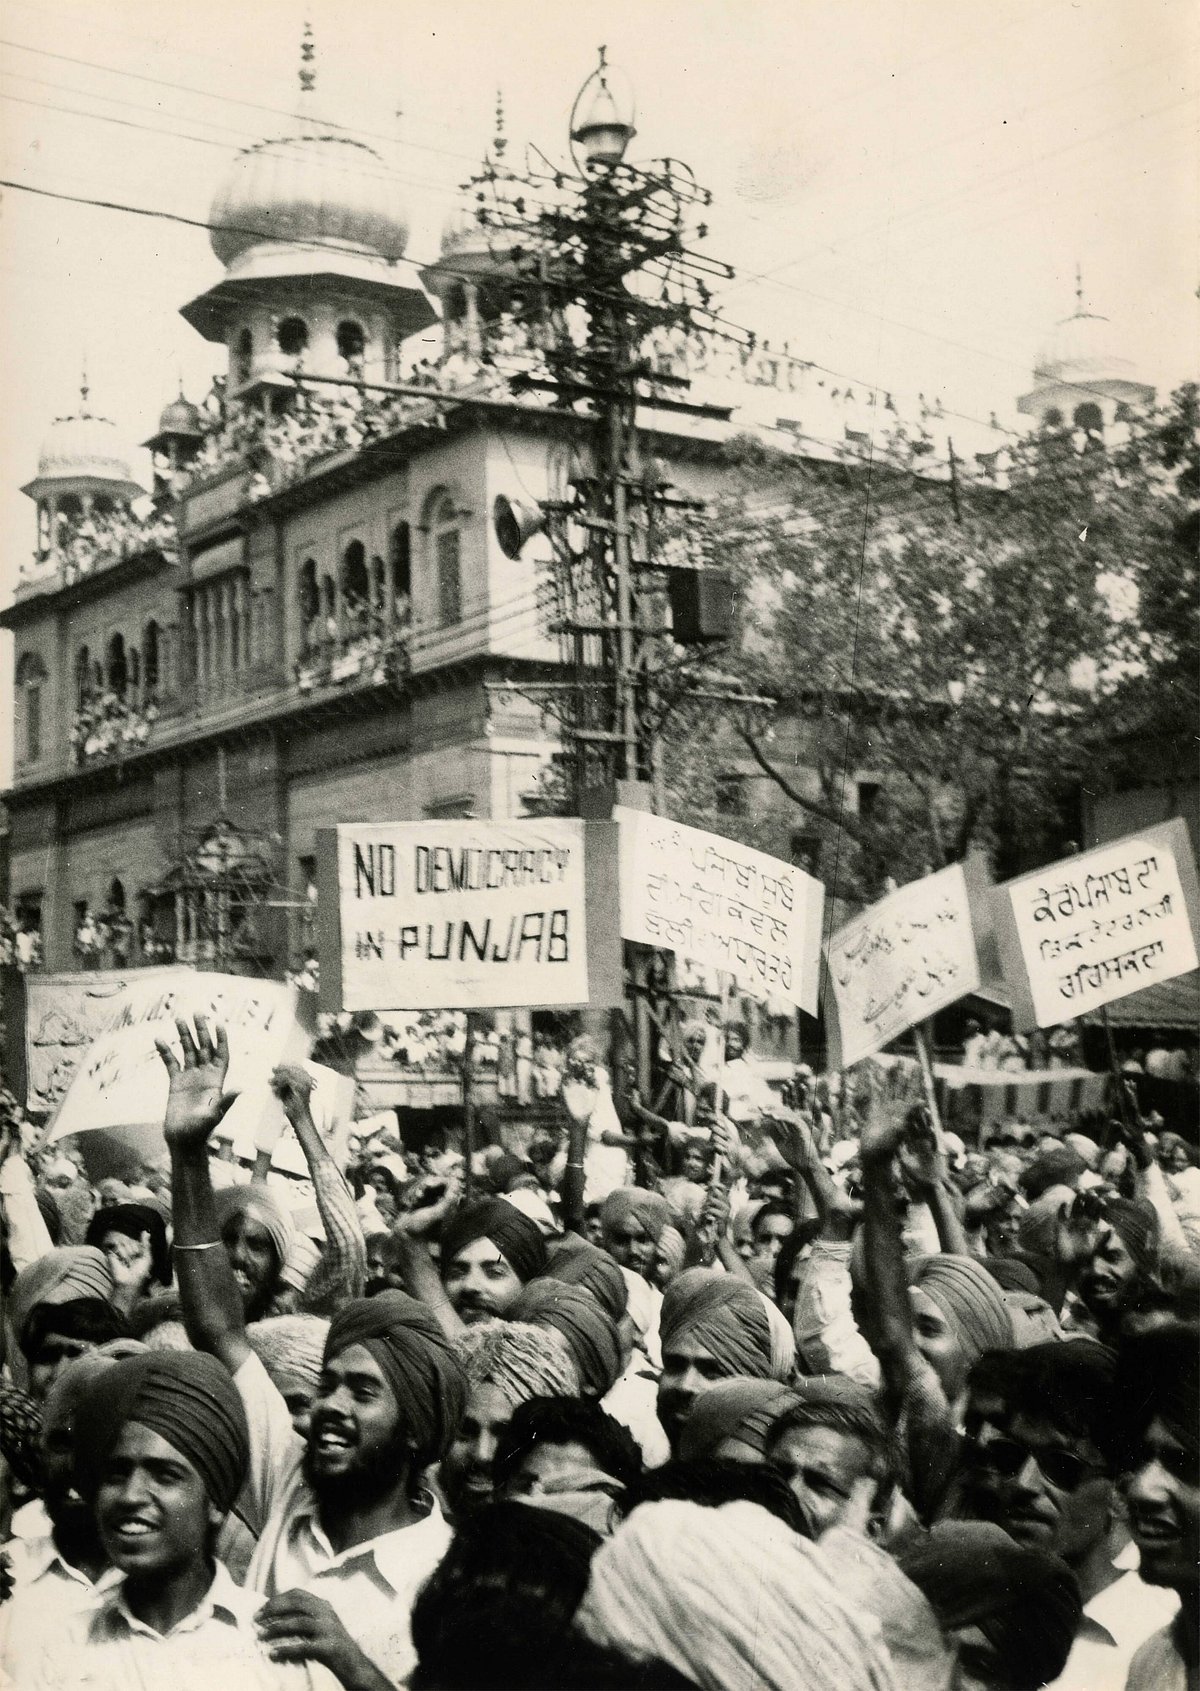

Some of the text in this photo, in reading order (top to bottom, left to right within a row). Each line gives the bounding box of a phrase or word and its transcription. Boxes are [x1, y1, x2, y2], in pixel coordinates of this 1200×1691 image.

[354, 844, 571, 899] NO DEMOCRACY
[1133, 856, 1158, 889] ਦਾ
[355, 909, 569, 963] IN PUNJAB
